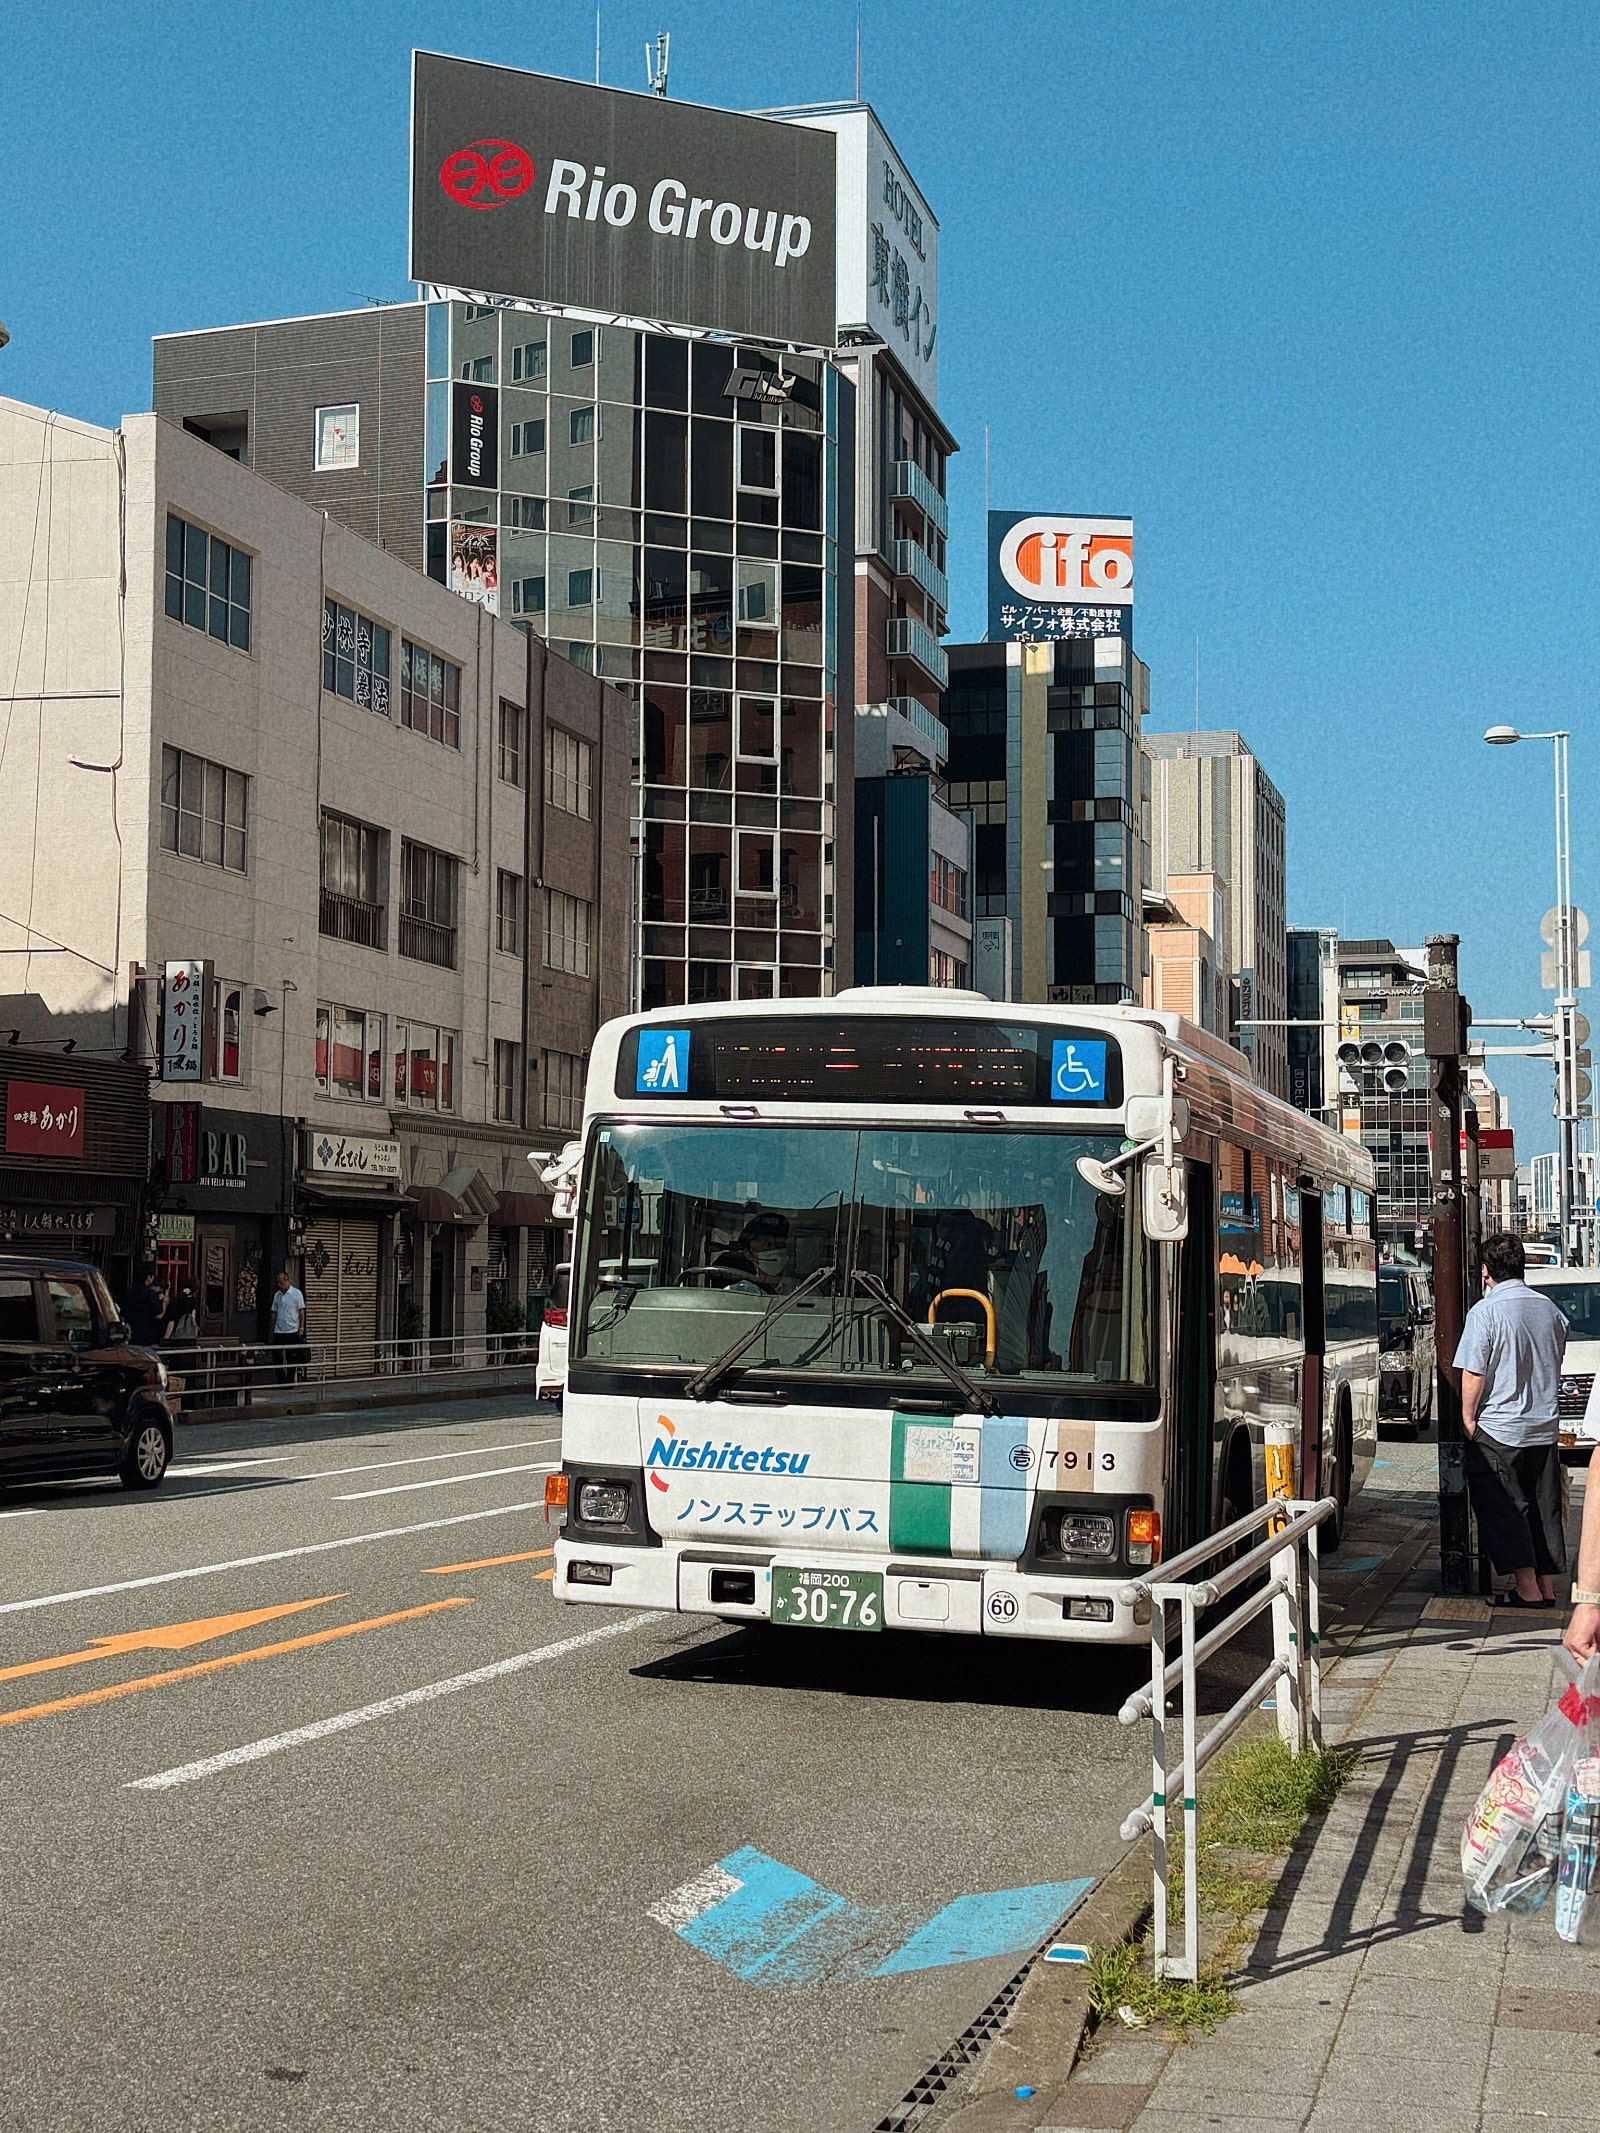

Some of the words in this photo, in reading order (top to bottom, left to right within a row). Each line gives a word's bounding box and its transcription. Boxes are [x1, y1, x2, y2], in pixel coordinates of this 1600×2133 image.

[544, 158, 638, 227] Rio
[648, 178, 813, 267] Group
[883, 160, 926, 262] HOTEL
[470, 414, 484, 437] Rio
[467, 436, 484, 478] Group
[1000, 615, 1121, 632] サイフォ株式会社
[172, 971, 192, 1053] あかり
[40, 1105, 78, 1138] あかり
[170, 1103, 185, 1181] BAR
[207, 1131, 248, 1176] BAR
[646, 1437, 811, 1474] Nishitetsu
[1045, 1451, 1115, 1471] 7913
[677, 1499, 879, 1533] ノンステップバス
[799, 1573, 822, 1585] 福岡
[823, 1574, 850, 1588] 200
[790, 1586, 877, 1627] 30-76
[991, 1599, 1016, 1616] 60
